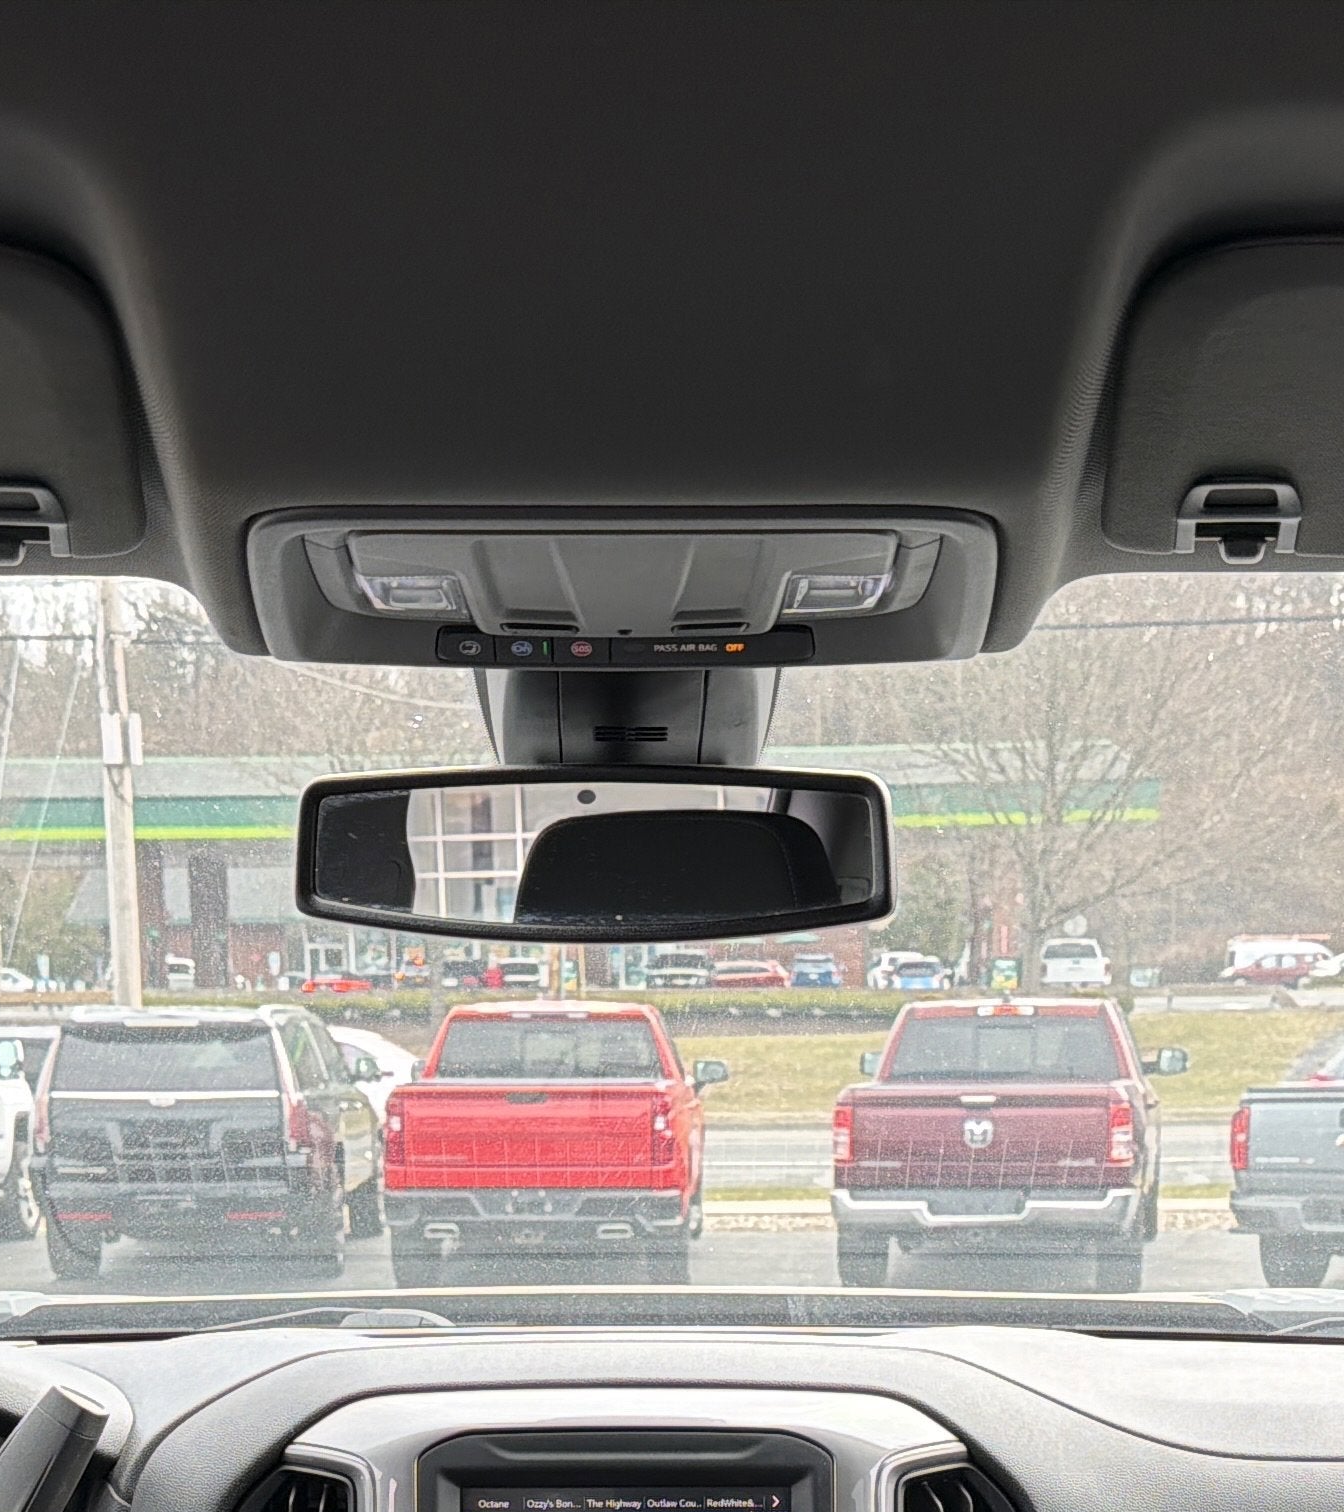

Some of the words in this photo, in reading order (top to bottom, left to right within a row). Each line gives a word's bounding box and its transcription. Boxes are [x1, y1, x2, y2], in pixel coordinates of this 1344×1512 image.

[571, 644, 592, 653] SOS
[654, 644, 677, 652] PASS
[680, 644, 696, 652] AIR
[698, 644, 718, 652] BAG
[725, 643, 745, 652] OFF
[478, 1499, 509, 1509] Octane
[526, 1499, 554, 1511] Ozzy's
[587, 1499, 604, 1509] The
[605, 1499, 642, 1511] Highway
[647, 1499, 678, 1509] Outlaw
